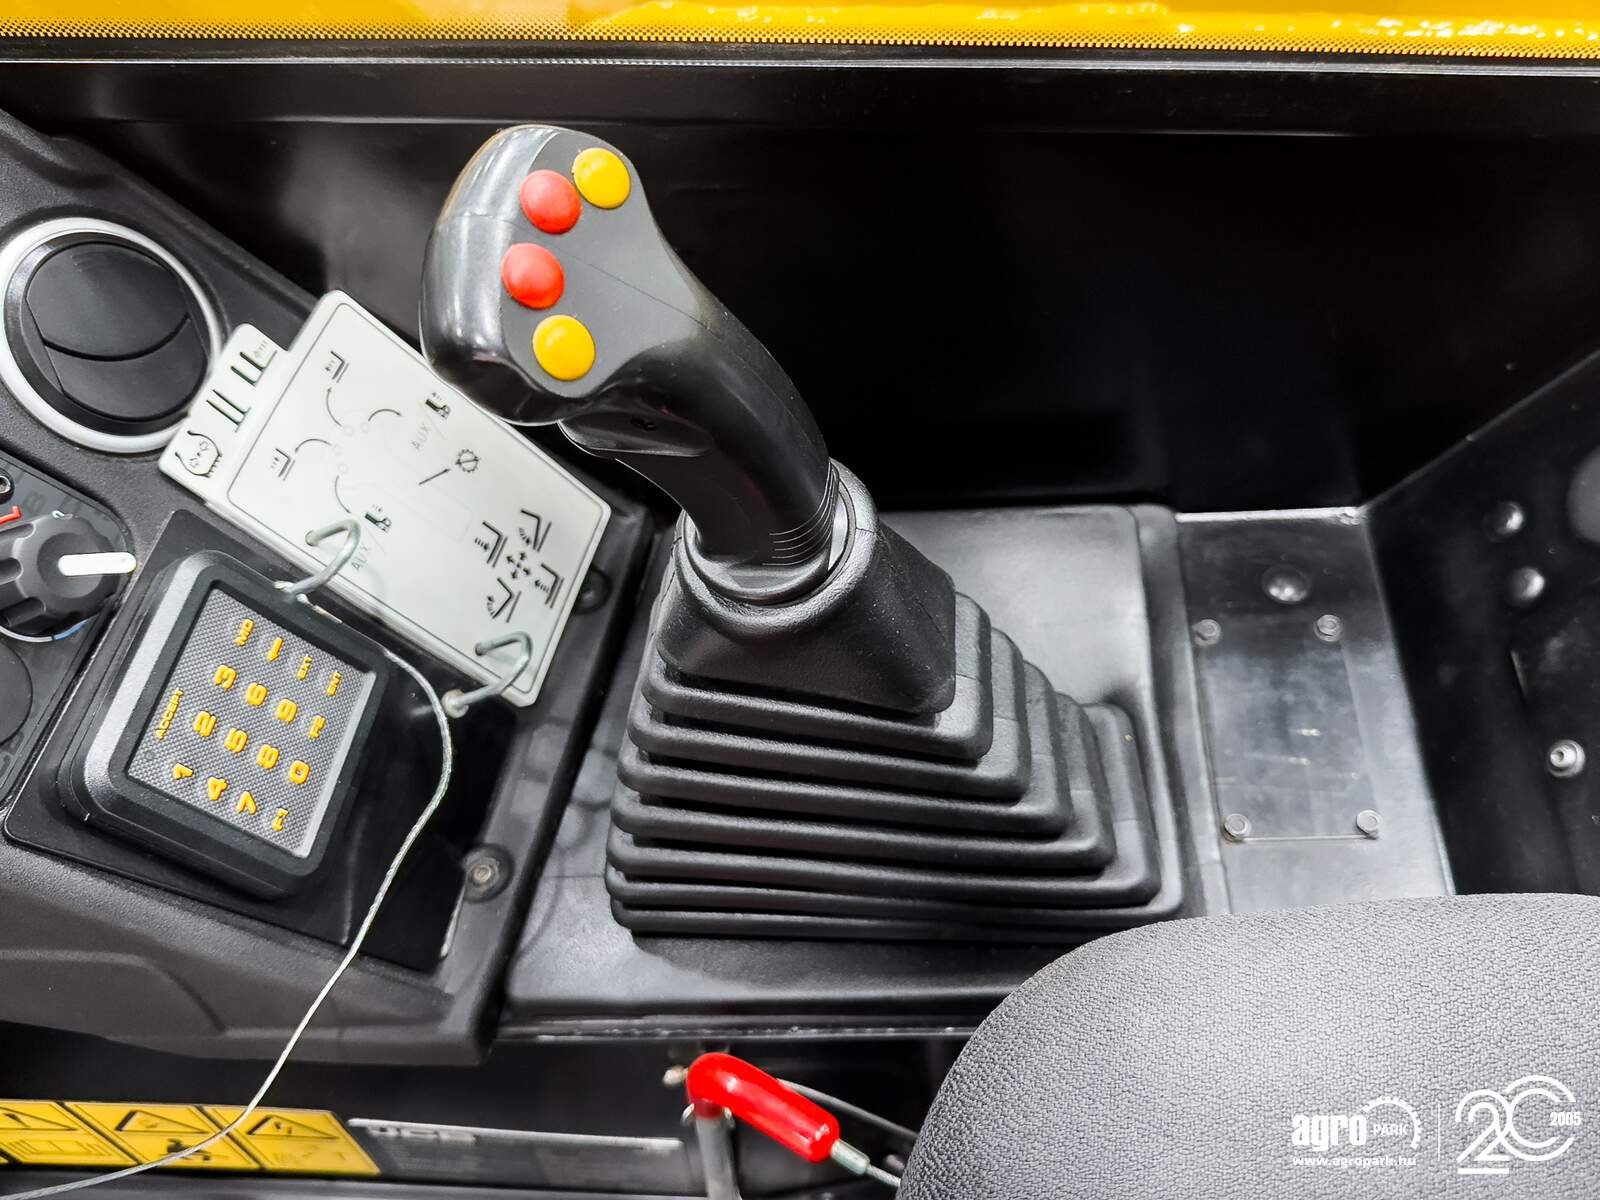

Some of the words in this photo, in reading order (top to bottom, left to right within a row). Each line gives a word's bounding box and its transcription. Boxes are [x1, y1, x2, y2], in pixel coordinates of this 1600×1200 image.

[411, 423, 432, 449] AUX
[351, 545, 371, 571] AUX
[214, 664, 238, 690] 3
[245, 682, 269, 708] 6
[155, 688, 184, 740] ACCEPT
[194, 711, 217, 737] 2
[276, 699, 299, 725] 9
[224, 727, 249, 753] 5
[309, 715, 327, 740] F2
[257, 744, 281, 770] 8
[173, 762, 194, 781] 1
[288, 760, 311, 785] 0
[207, 776, 229, 801] 4
[236, 790, 258, 816] 7
